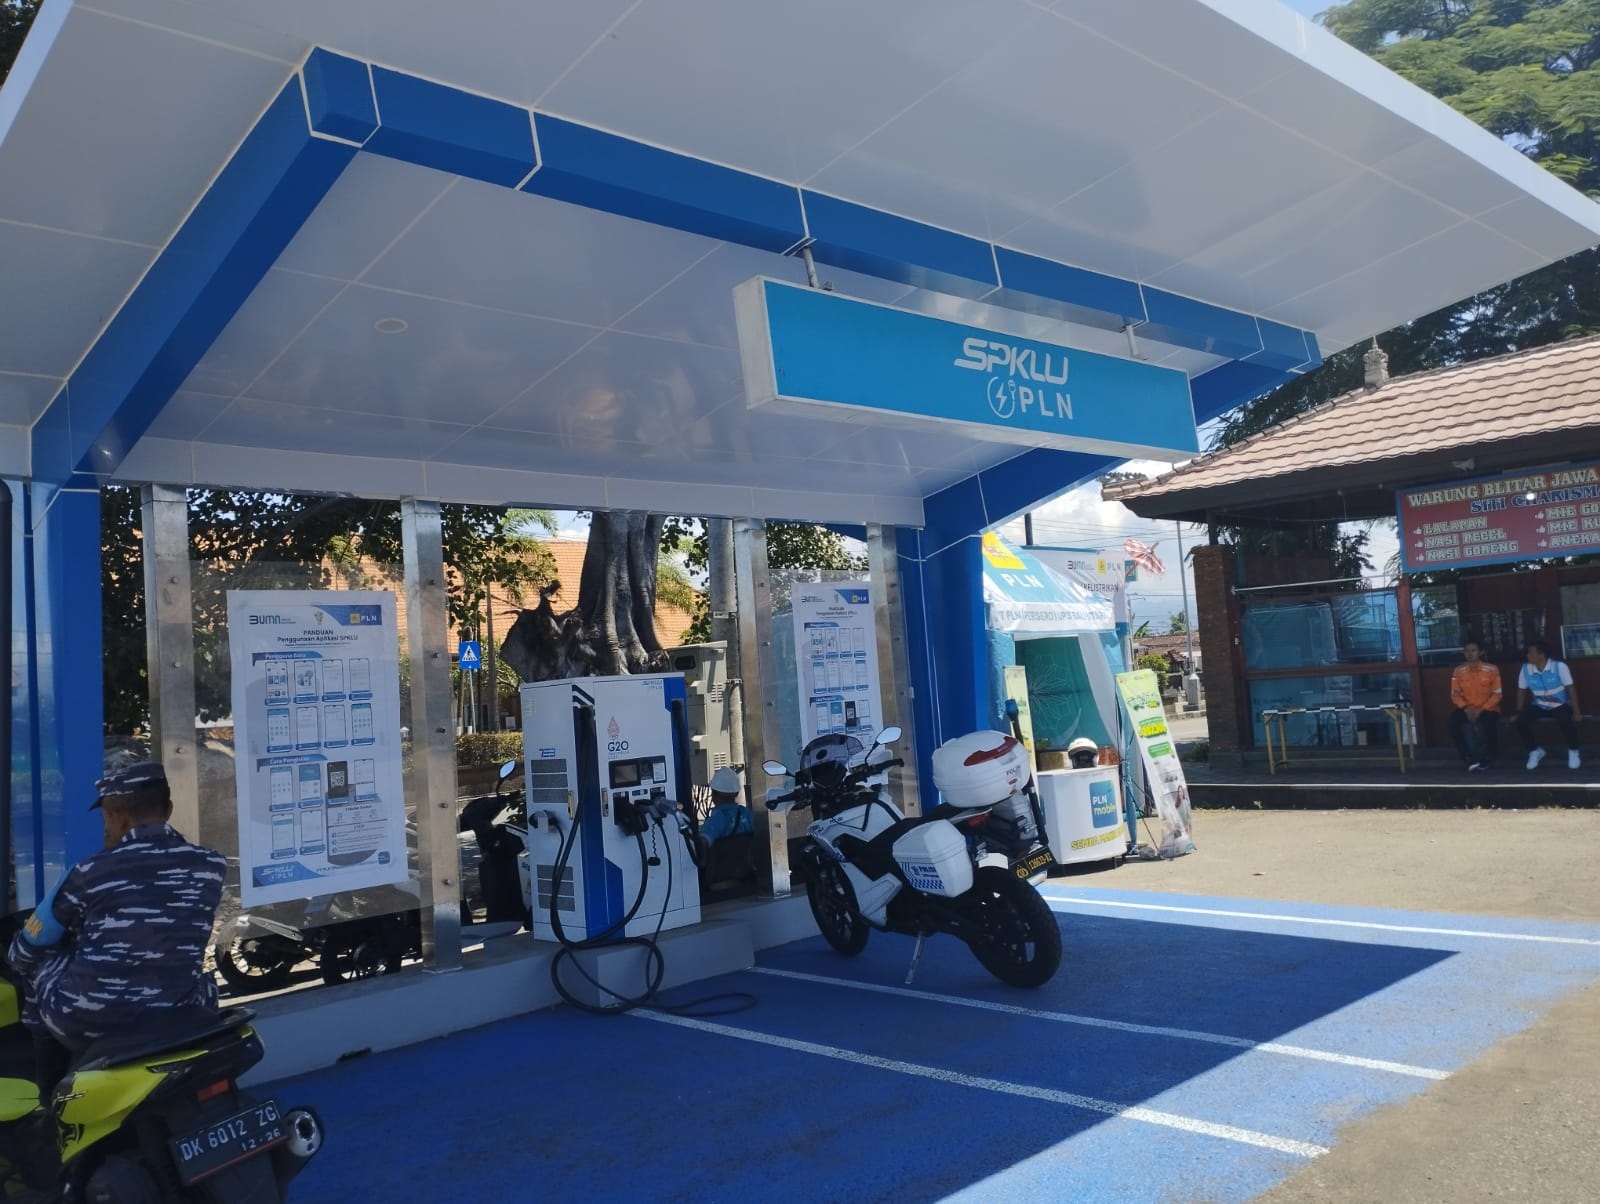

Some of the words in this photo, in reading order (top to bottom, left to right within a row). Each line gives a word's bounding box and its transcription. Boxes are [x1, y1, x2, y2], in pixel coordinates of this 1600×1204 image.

[954, 337, 1069, 385] SPKLU
[1018, 386, 1073, 420] PLN
[1408, 485, 1478, 507] WARUNG
[1483, 475, 1547, 494] BLITAR
[1552, 468, 1599, 486] JAWA
[1511, 484, 1600, 507] CHARISM
[1546, 505, 1576, 520] MIE
[1581, 502, 1600, 515] GO
[1548, 519, 1577, 533] MIE
[1425, 534, 1459, 548] NASI
[1463, 528, 1506, 544] PECEL
[1427, 547, 1460, 561] NASI
[1464, 540, 1518, 557] GORENG
[1000, 573, 1044, 589] PLN
[608, 740, 630, 752] G20
[1092, 795, 1108, 806] PLN
[180, 1137, 205, 1161] DK
[208, 1119, 248, 1148] 6012
[255, 1106, 278, 1127] ZG
